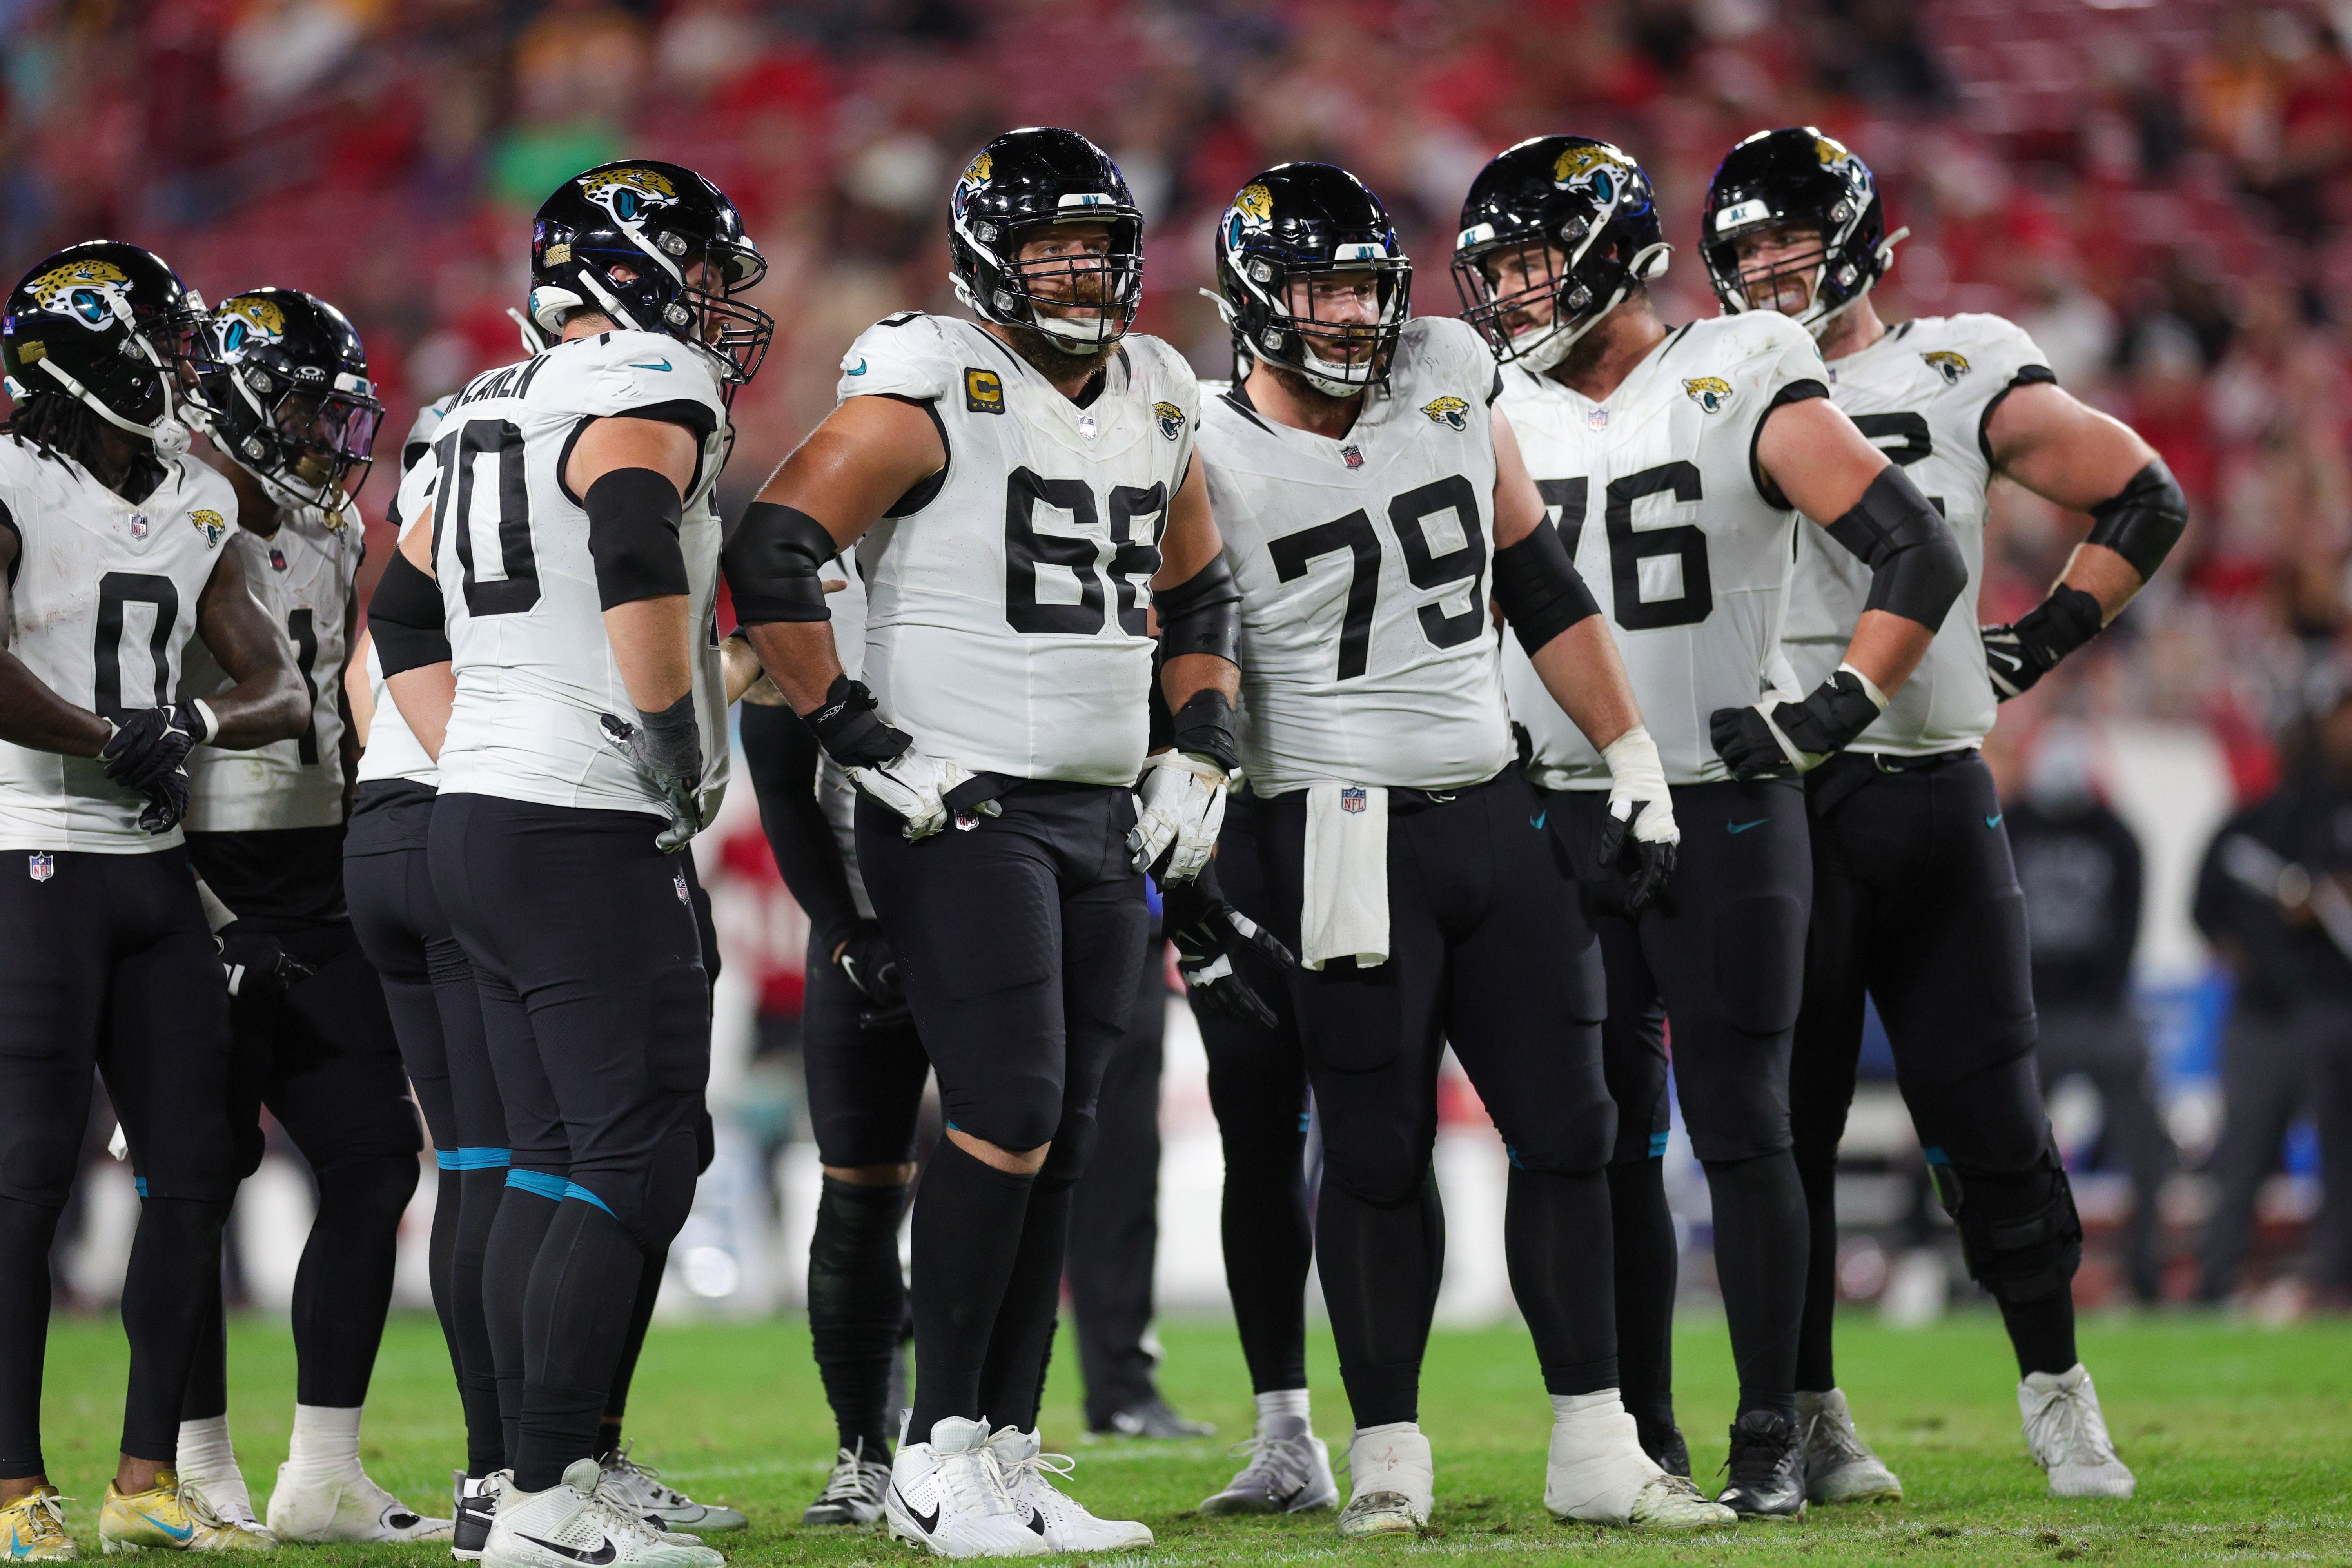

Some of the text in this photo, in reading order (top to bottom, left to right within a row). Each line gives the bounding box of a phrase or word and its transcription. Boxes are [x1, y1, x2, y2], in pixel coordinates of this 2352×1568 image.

[1355, 246, 1375, 259] JAX
[294, 373, 325, 381] OAKLEY
[968, 371, 1000, 402] C
[1346, 454, 1362, 465] NFL
[431, 419, 541, 618] 70
[133, 524, 146, 535] NFL
[1006, 466, 1167, 636] 68
[1533, 460, 1713, 632] 76
[1268, 474, 1485, 681] 79
[94, 572, 179, 722] 0
[288, 609, 319, 765] 1
[1344, 798, 1364, 811] NFL
[958, 817, 976, 826] NFL
[34, 865, 50, 877] NFL
[510, 1548, 563, 1568] FORCE
